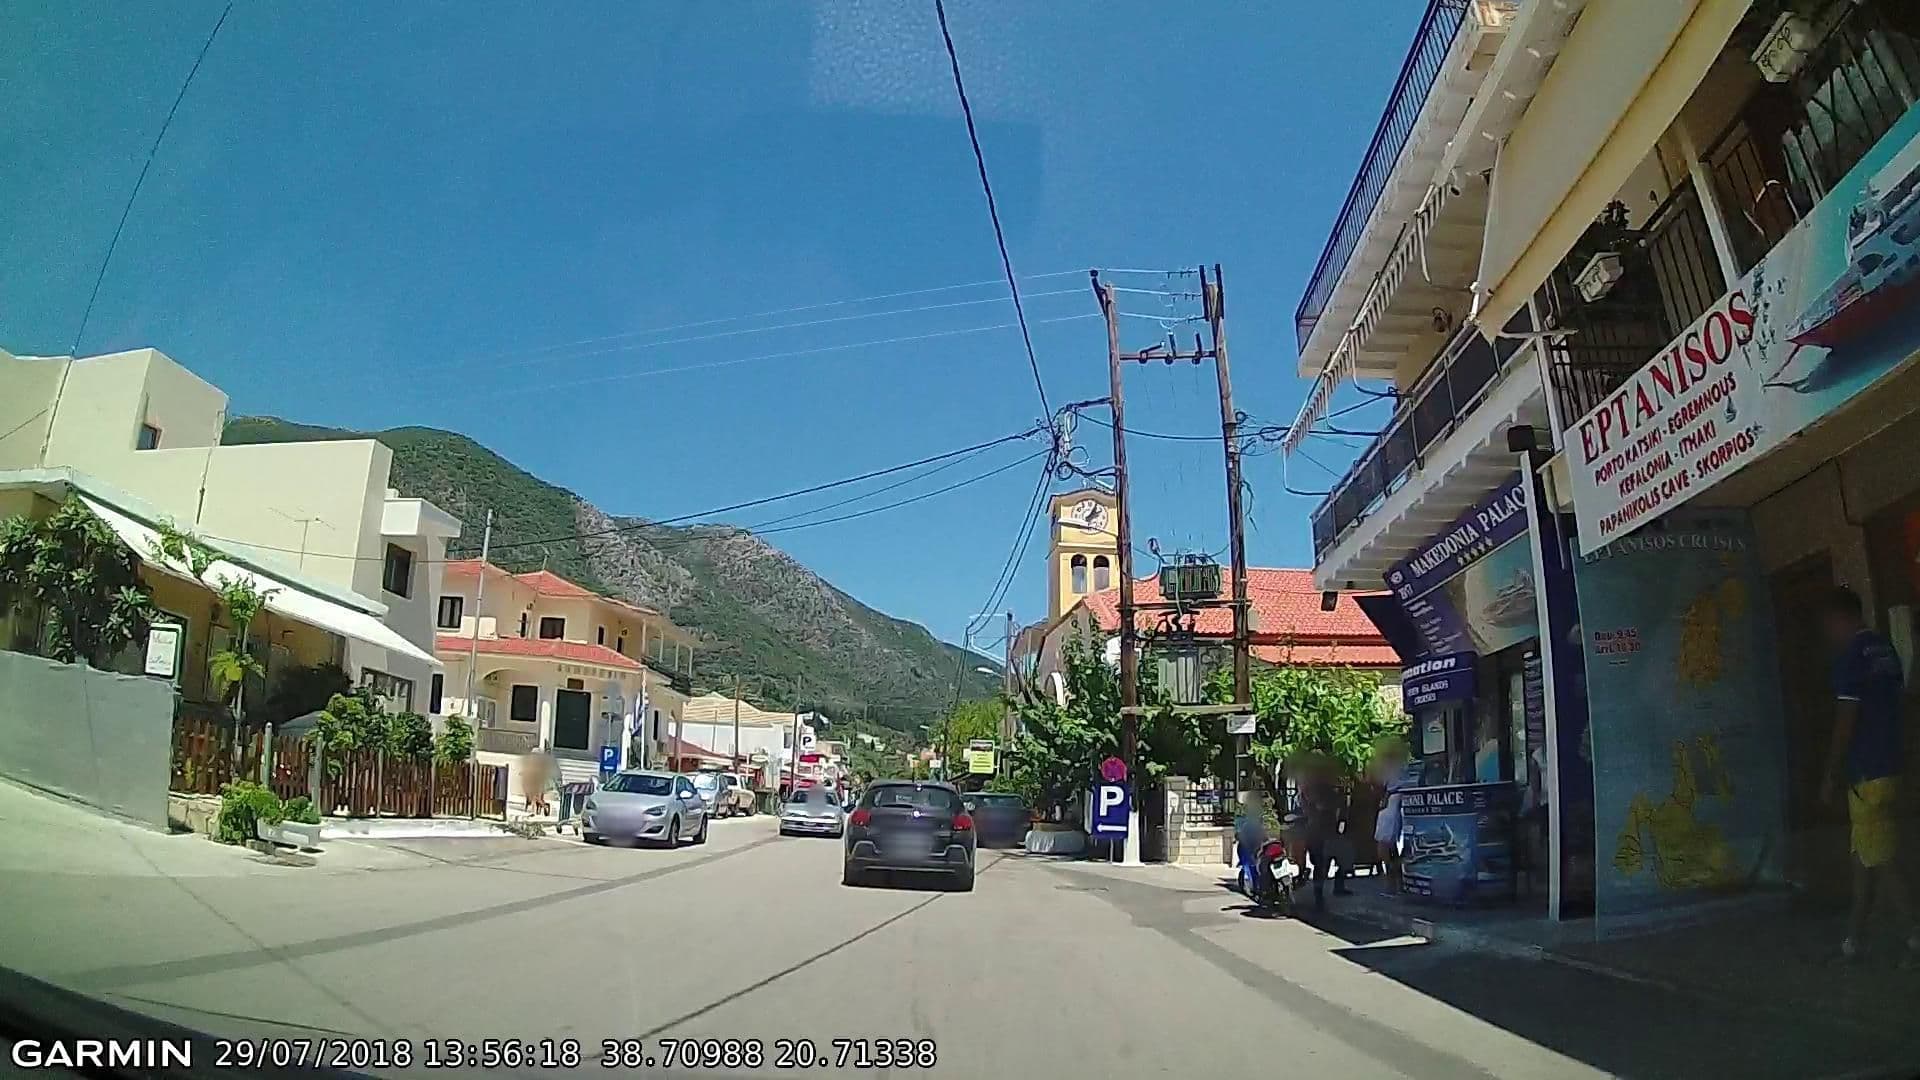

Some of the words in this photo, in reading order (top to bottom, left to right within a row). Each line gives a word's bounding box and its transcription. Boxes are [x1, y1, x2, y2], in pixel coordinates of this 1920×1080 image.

[1579, 289, 1755, 466] EPTANISOS
[1595, 454, 1625, 487] PORTO
[1625, 427, 1662, 465] KATSIKI
[1667, 371, 1737, 435] EGREMNOUS
[1619, 451, 1674, 498] KEFALONIA
[1679, 419, 1717, 458] ITHAKI
[1600, 487, 1661, 536] PAPANIKOLIS
[1661, 469, 1690, 499] CAVE
[1695, 427, 1754, 479] SKORPIOS
[1409, 524, 1480, 578] MAKEDONIA
[1477, 485, 1528, 532] PALAC
[604, 748, 614, 761] P
[1100, 785, 1124, 817] P
[1427, 791, 1464, 805] PALACE
